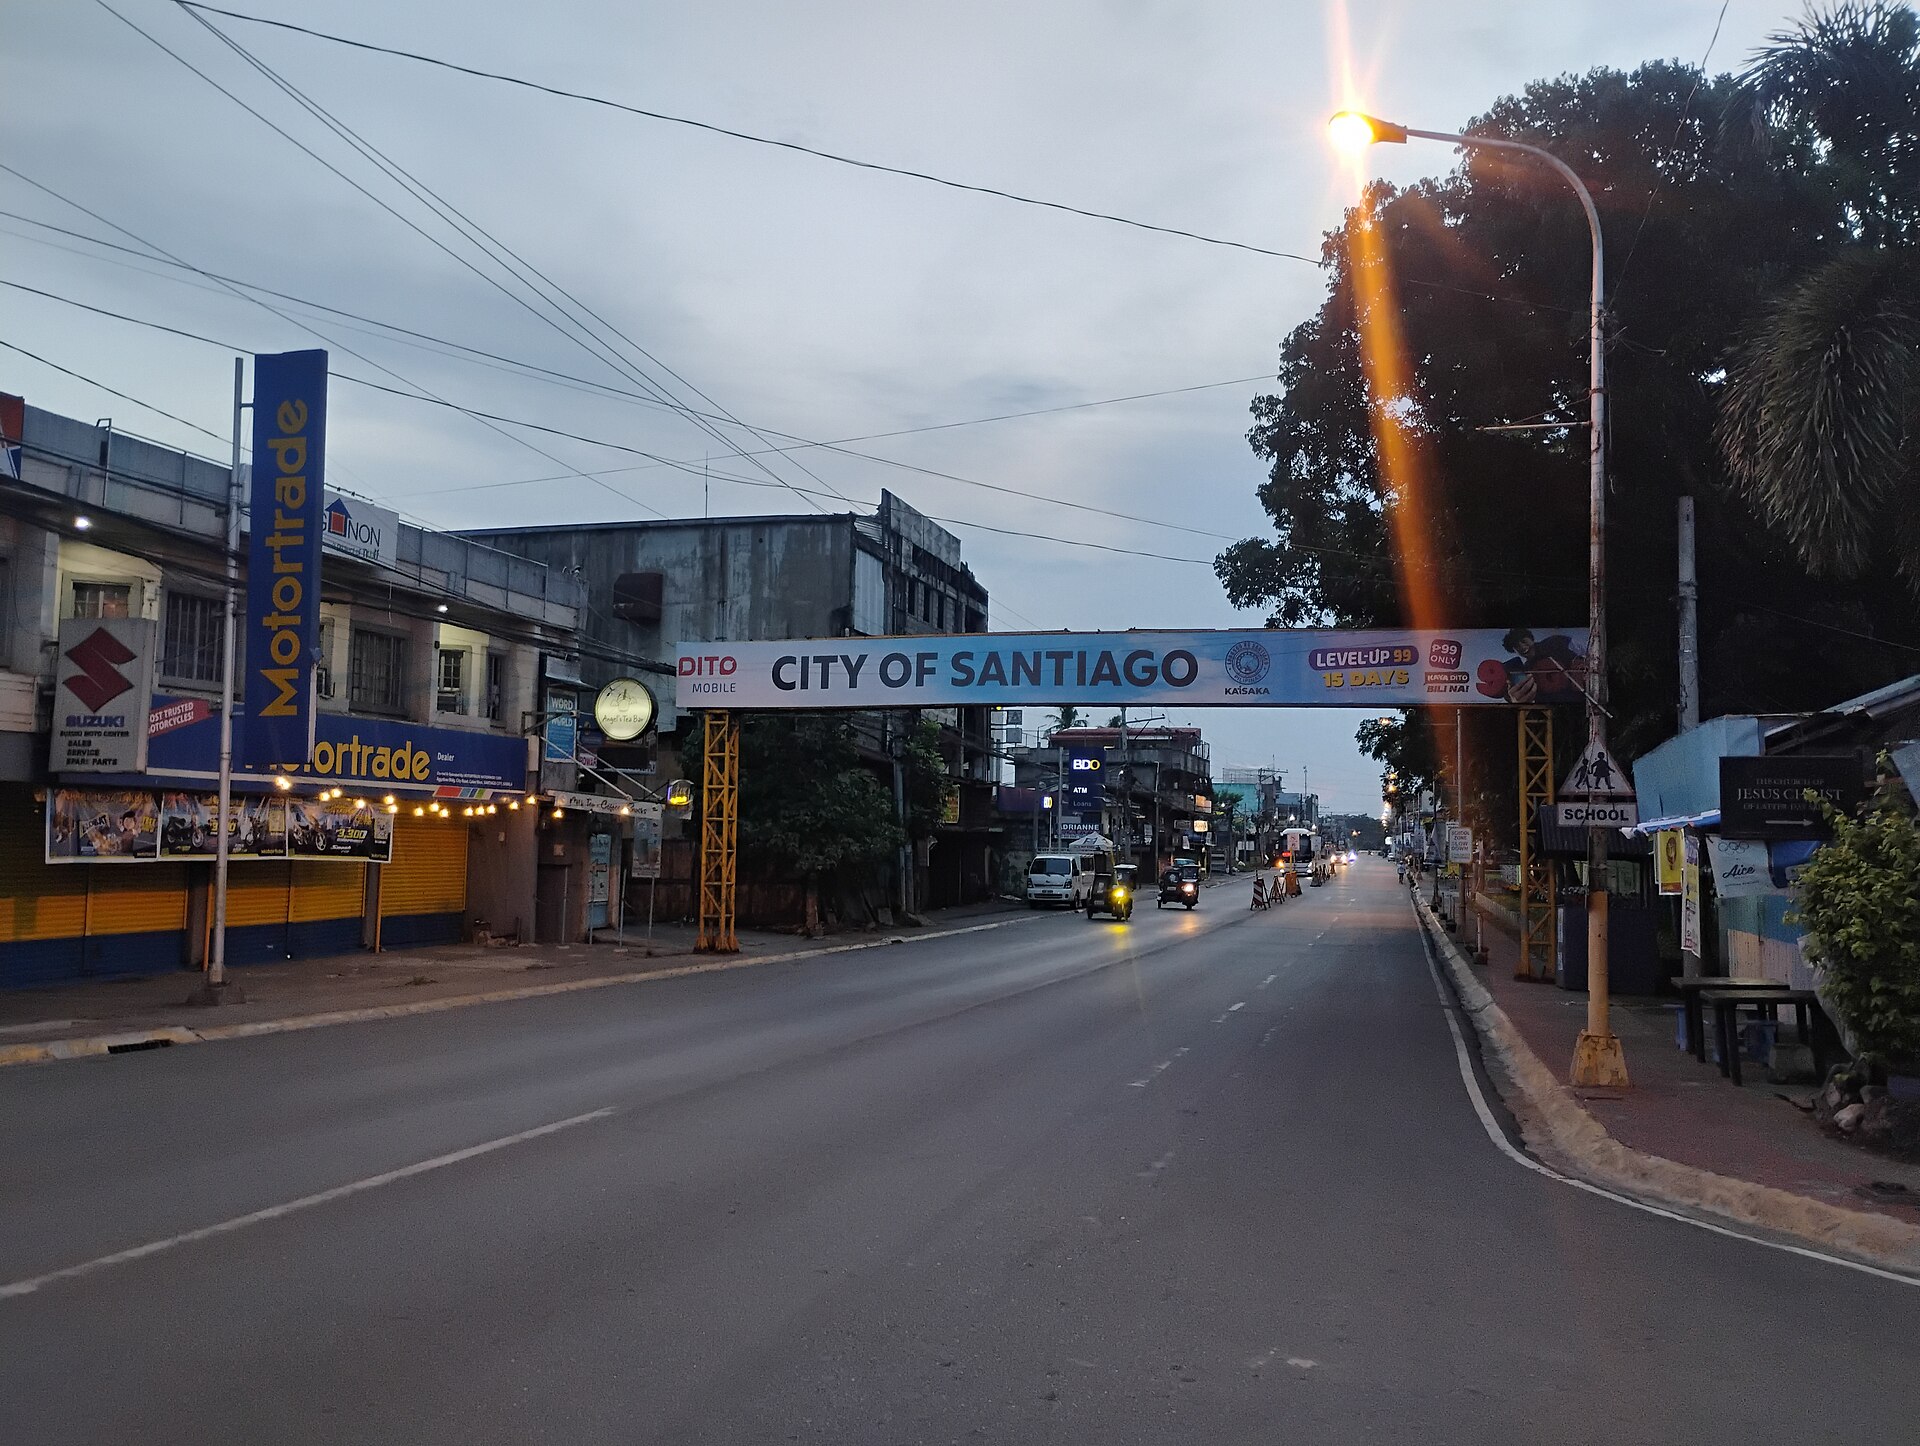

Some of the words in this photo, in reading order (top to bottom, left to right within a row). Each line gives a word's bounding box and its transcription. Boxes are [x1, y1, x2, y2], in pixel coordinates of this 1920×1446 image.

[259, 398, 308, 717] Motortrade
[1316, 648, 1390, 667] LEVEL-UP
[1393, 649, 1412, 663] 99
[1430, 654, 1456, 665] ONLY
[678, 655, 737, 676] DITO
[771, 654, 868, 690] CITY
[879, 652, 939, 688] OF
[951, 649, 1198, 687] SANTIAGO
[1322, 672, 1345, 688] 15
[1349, 669, 1410, 687] DAYS
[692, 683, 736, 693] MOBILE
[1426, 685, 1447, 693] BILI
[551, 697, 574, 711] WORD
[149, 711, 164, 723] OST
[164, 702, 194, 719] TRUSTED
[66, 715, 125, 728] SUZUKI
[149, 711, 194, 734] OTORCYCLES!
[92, 758, 117, 766] PARTS
[437, 752, 455, 762] Dealer
[1072, 758, 1101, 770] BDO
[1072, 786, 1088, 794] ATM
[1737, 787, 1780, 801] JESUS
[1783, 788, 1844, 801] CIST
[1564, 808, 1629, 821] SCHOOL
[1061, 823, 1100, 831] DRIANNE
[336, 828, 369, 840] 3,300
[1722, 864, 1755, 879] Aice
